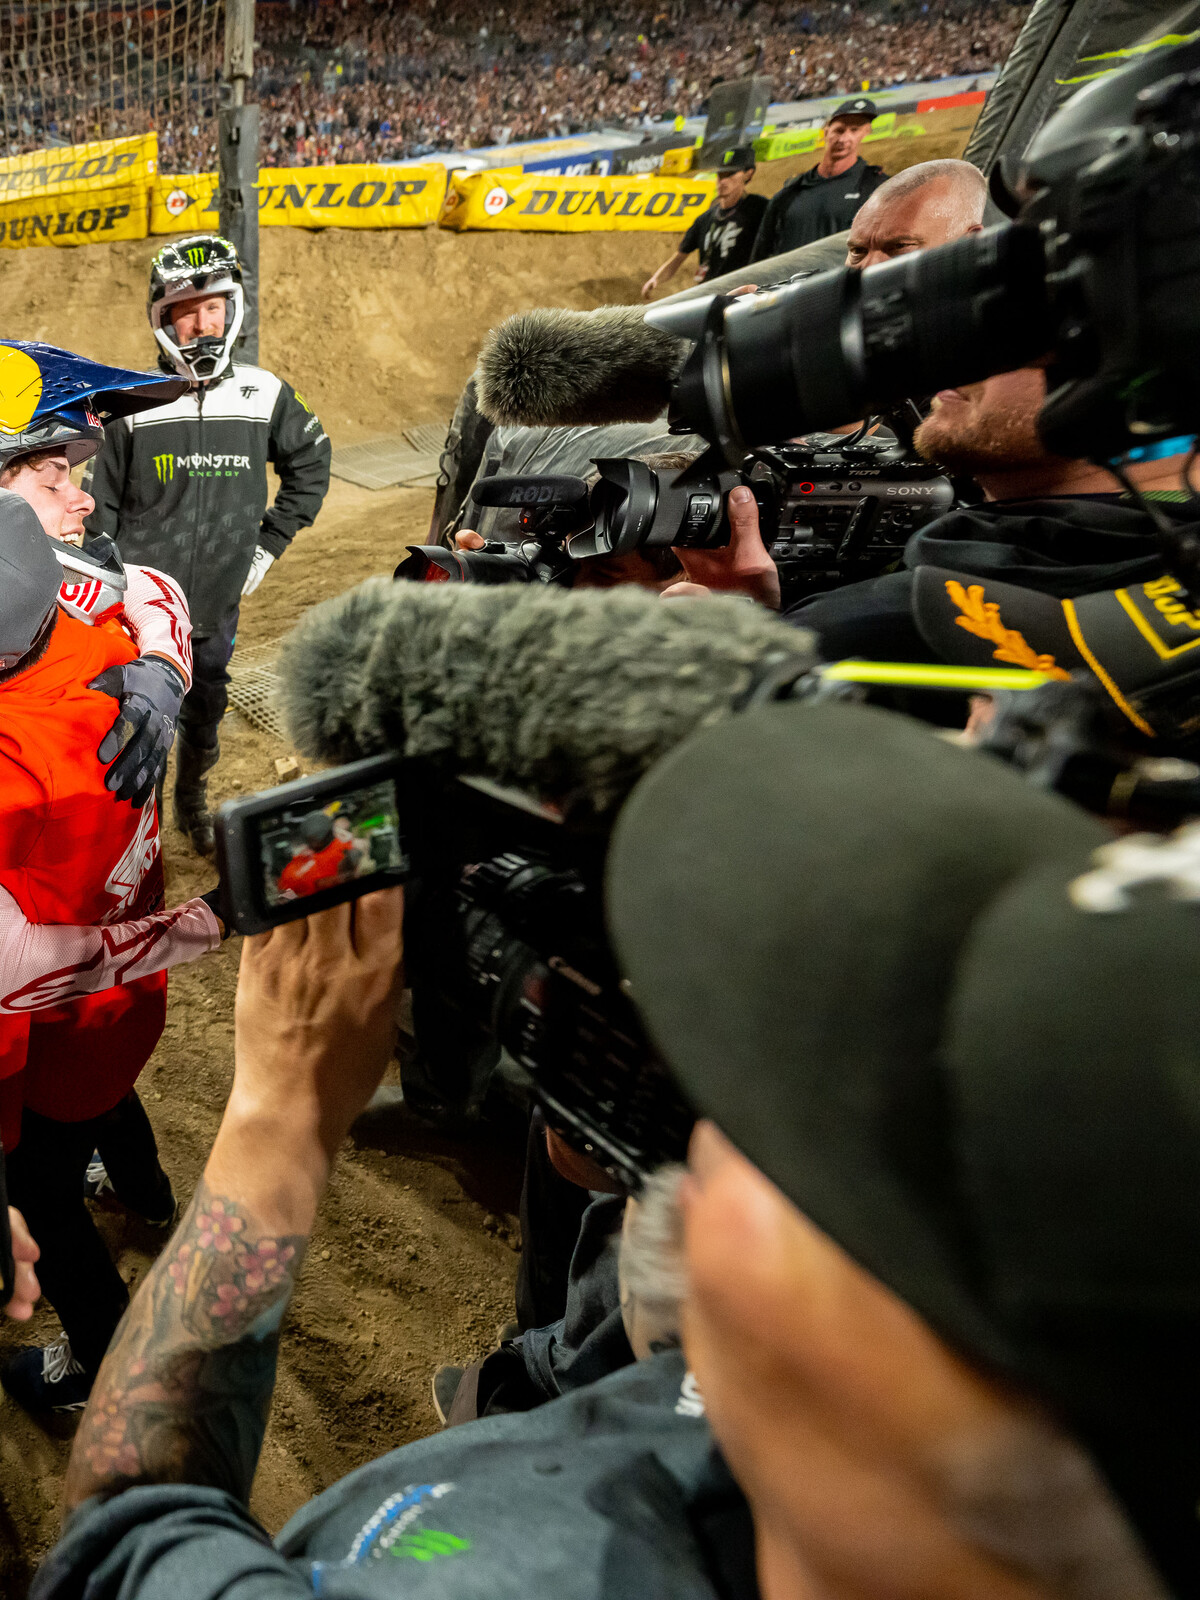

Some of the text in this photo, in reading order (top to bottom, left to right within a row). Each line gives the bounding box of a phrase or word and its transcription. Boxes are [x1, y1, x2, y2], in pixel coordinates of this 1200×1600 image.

[519, 190, 706, 217] DUNLOP
[177, 453, 250, 470] MONSTER
[887, 487, 935, 496] SONY
